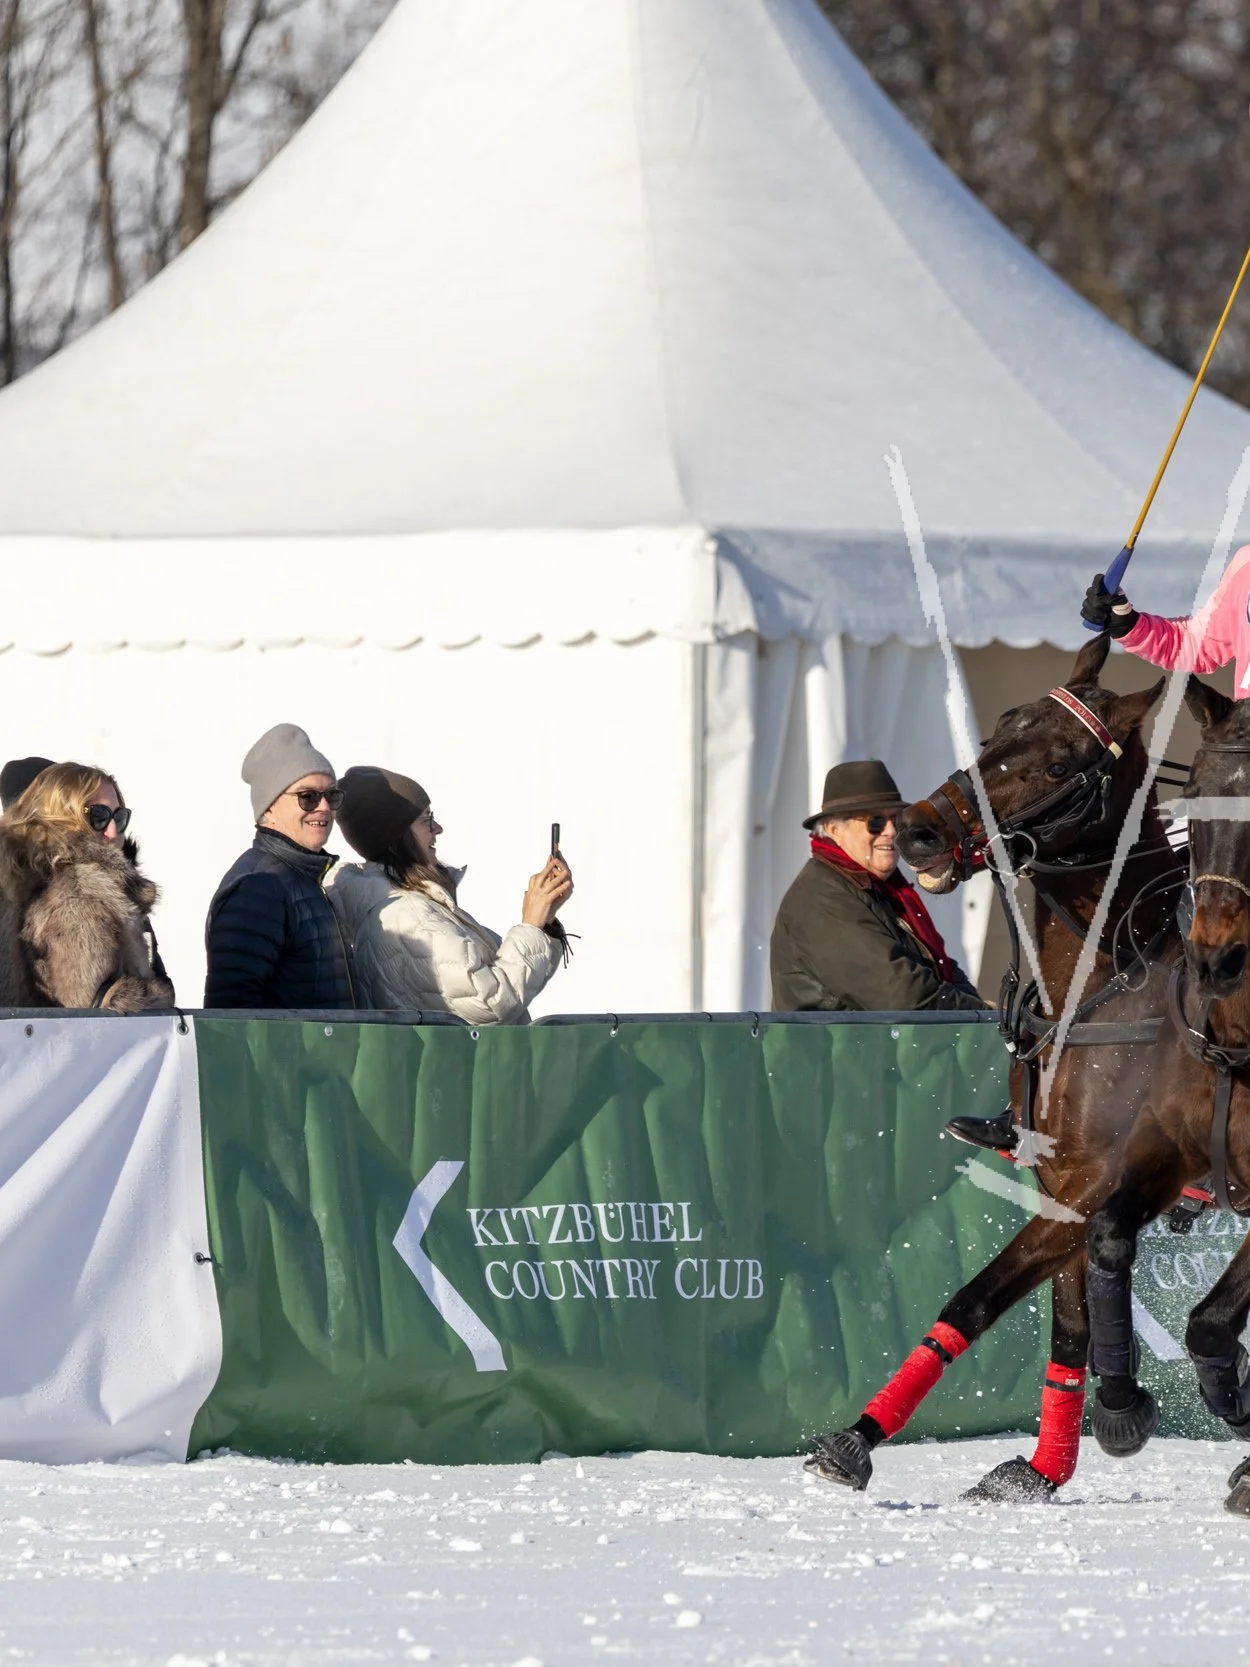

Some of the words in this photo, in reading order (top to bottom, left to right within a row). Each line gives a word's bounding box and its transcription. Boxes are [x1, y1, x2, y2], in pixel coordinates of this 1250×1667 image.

[466, 1201, 703, 1246] KITZBÜHEL
[485, 1257, 661, 1300] COUNTRY
[674, 1257, 764, 1300] CLUB
